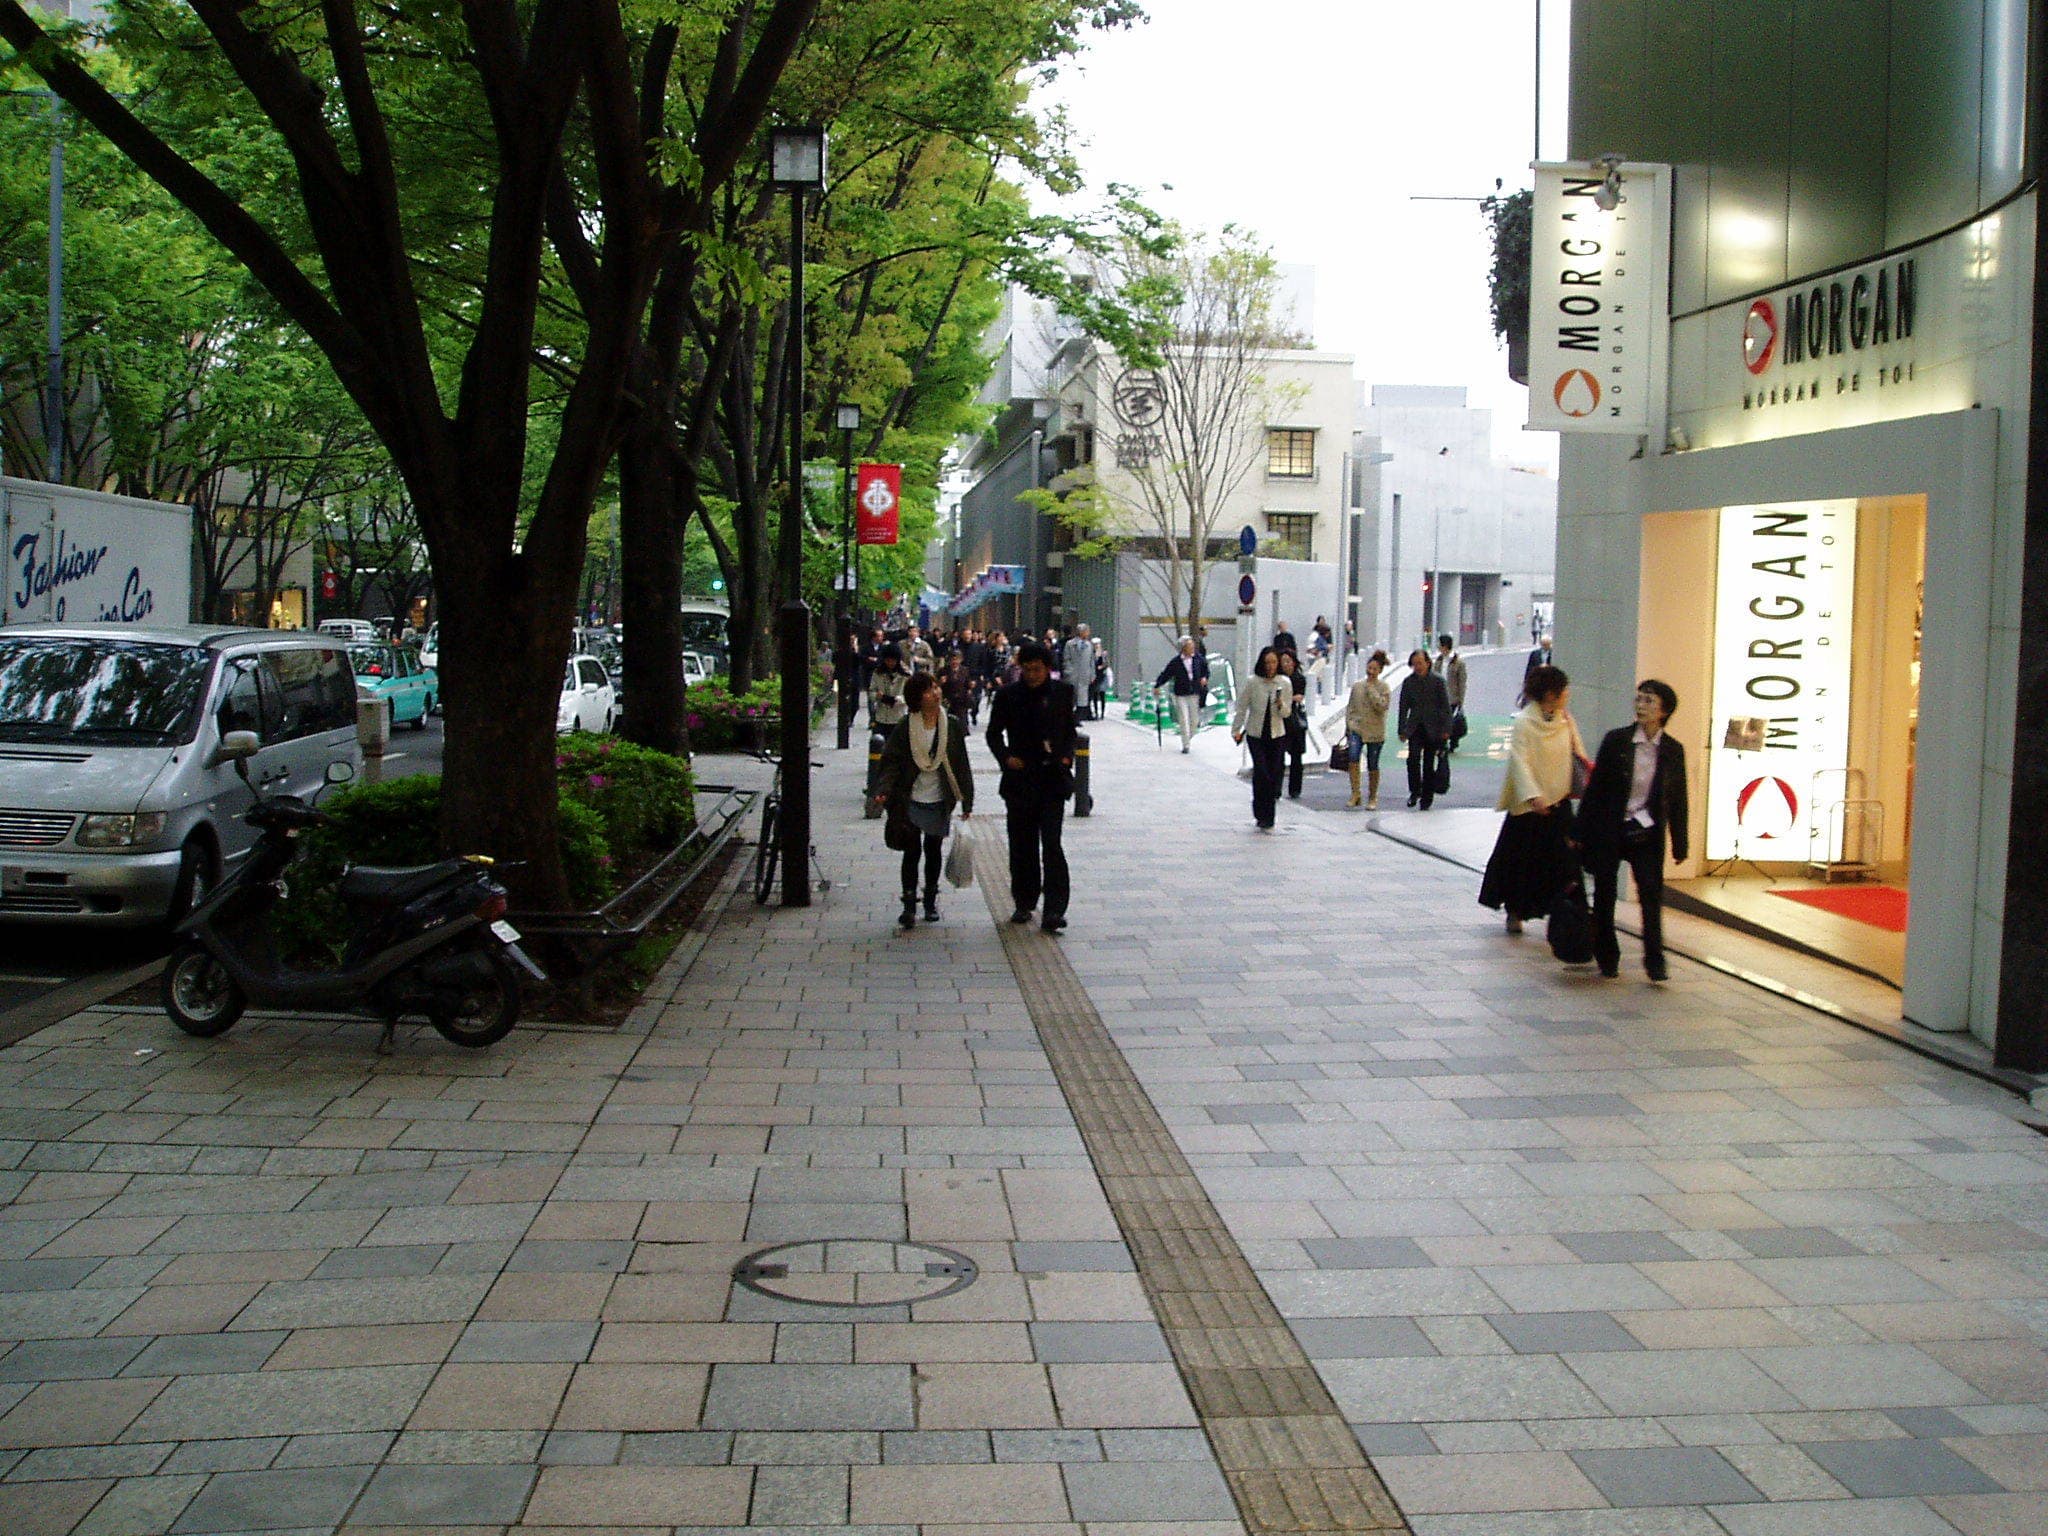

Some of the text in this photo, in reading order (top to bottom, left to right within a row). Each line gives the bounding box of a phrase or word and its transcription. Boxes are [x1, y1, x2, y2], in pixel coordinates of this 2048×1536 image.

[1615, 249, 1627, 277] DE
[1782, 258, 1919, 365] MORGAN
[1611, 303, 1624, 417] MORGAN
[1743, 361, 1914, 410] MORGAN DE TOI
[1745, 511, 1809, 751] MORGAN
[1817, 610, 1832, 646] DE
